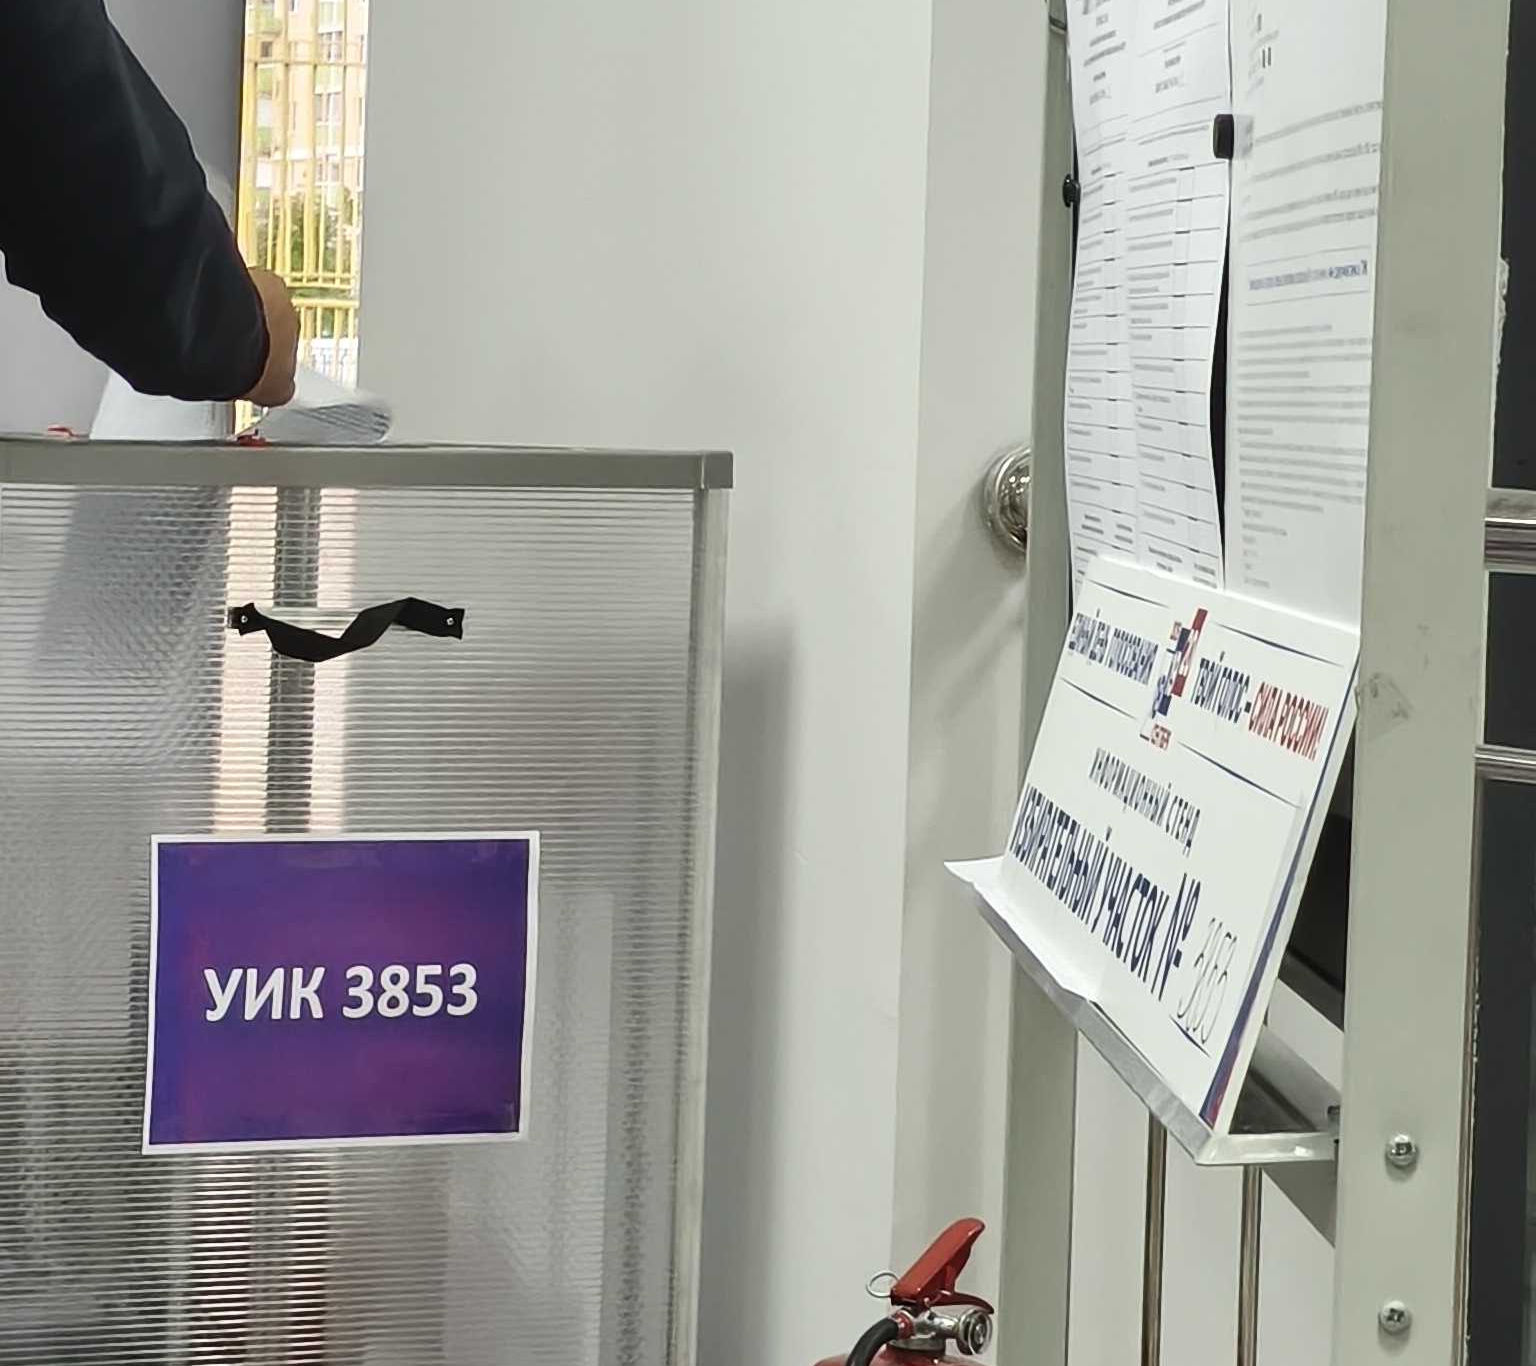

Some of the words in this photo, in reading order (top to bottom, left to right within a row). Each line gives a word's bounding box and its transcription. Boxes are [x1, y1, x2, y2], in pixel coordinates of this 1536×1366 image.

[1190, 650, 1226, 710] ТВОЙ
[1212, 666, 1251, 723] ГОЛОС
[1249, 681, 1284, 739] СИЛА
[1273, 692, 1329, 760] РОССИИ!
[1089, 747, 1172, 826] ИНФОРМАЦИОННЫЙ
[1166, 796, 1201, 857] СТЕНД
[1009, 784, 1113, 926] ИЗБИРАТЕЛЬНЫЙ
[1091, 852, 1170, 983] УЧАСТОК
[1151, 873, 1202, 1002] №
[1177, 918, 1237, 1044] 3853
[202, 966, 325, 1022] УИК
[342, 963, 478, 1019] 3853
